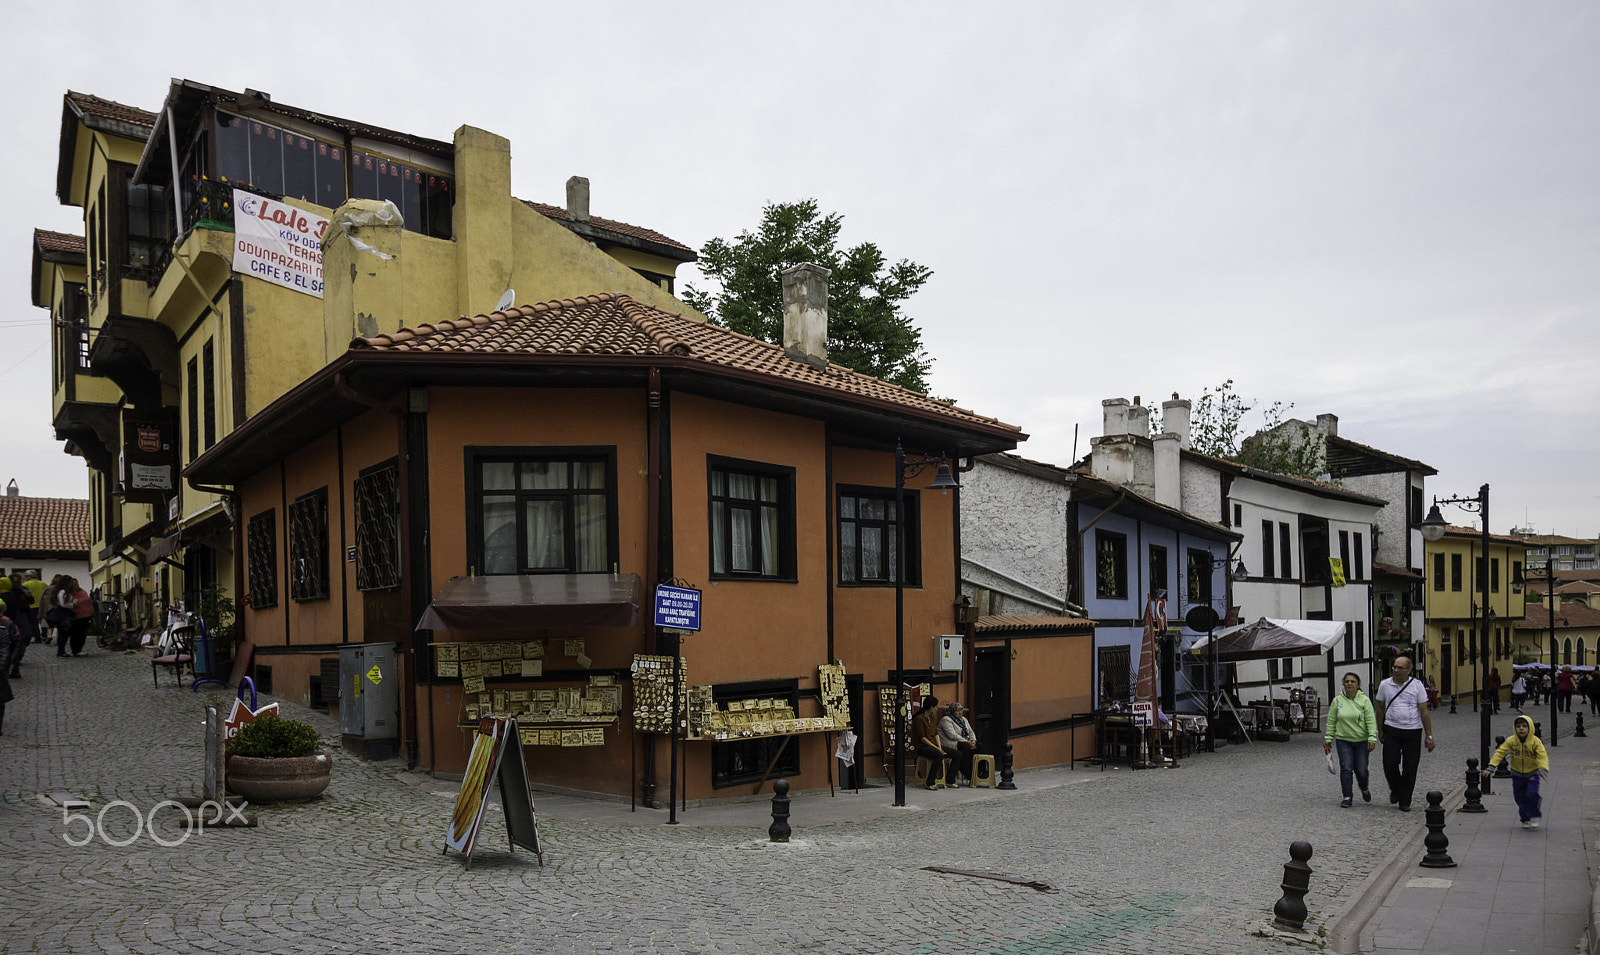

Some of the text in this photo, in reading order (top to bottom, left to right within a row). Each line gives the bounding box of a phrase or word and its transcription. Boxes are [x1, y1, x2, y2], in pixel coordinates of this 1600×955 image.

[257, 200, 309, 234] Lale
[279, 230, 300, 243] KÖY
[238, 240, 312, 275] ODUNPAZARI
[287, 243, 323, 265] TERAS
[251, 259, 280, 280] CAFE
[295, 274, 308, 289] EL
